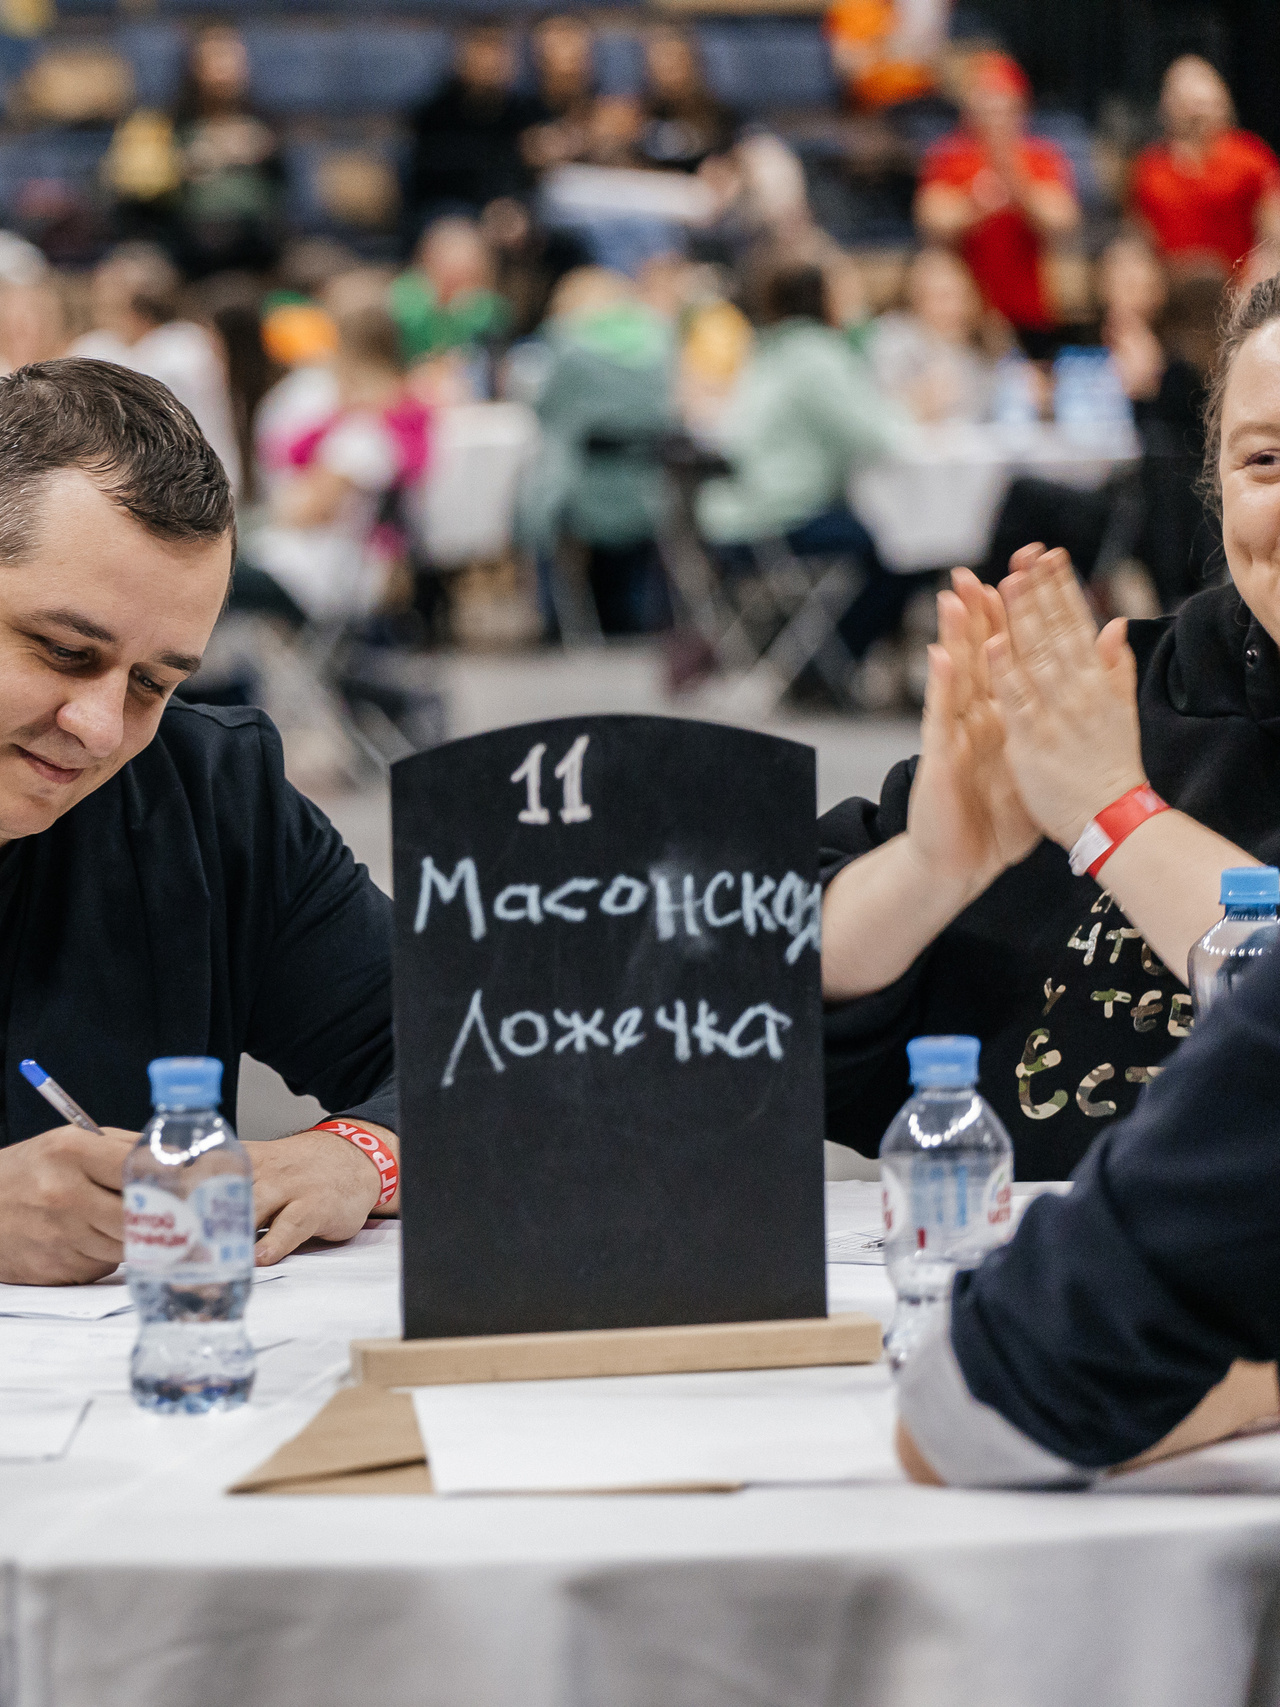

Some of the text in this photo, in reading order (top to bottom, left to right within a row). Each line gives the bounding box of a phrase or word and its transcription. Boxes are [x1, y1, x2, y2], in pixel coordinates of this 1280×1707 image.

[511, 735, 592, 825] 11
[441, 989, 792, 1088] Ложечка
[1090, 988, 1195, 1038] ТЕБ
